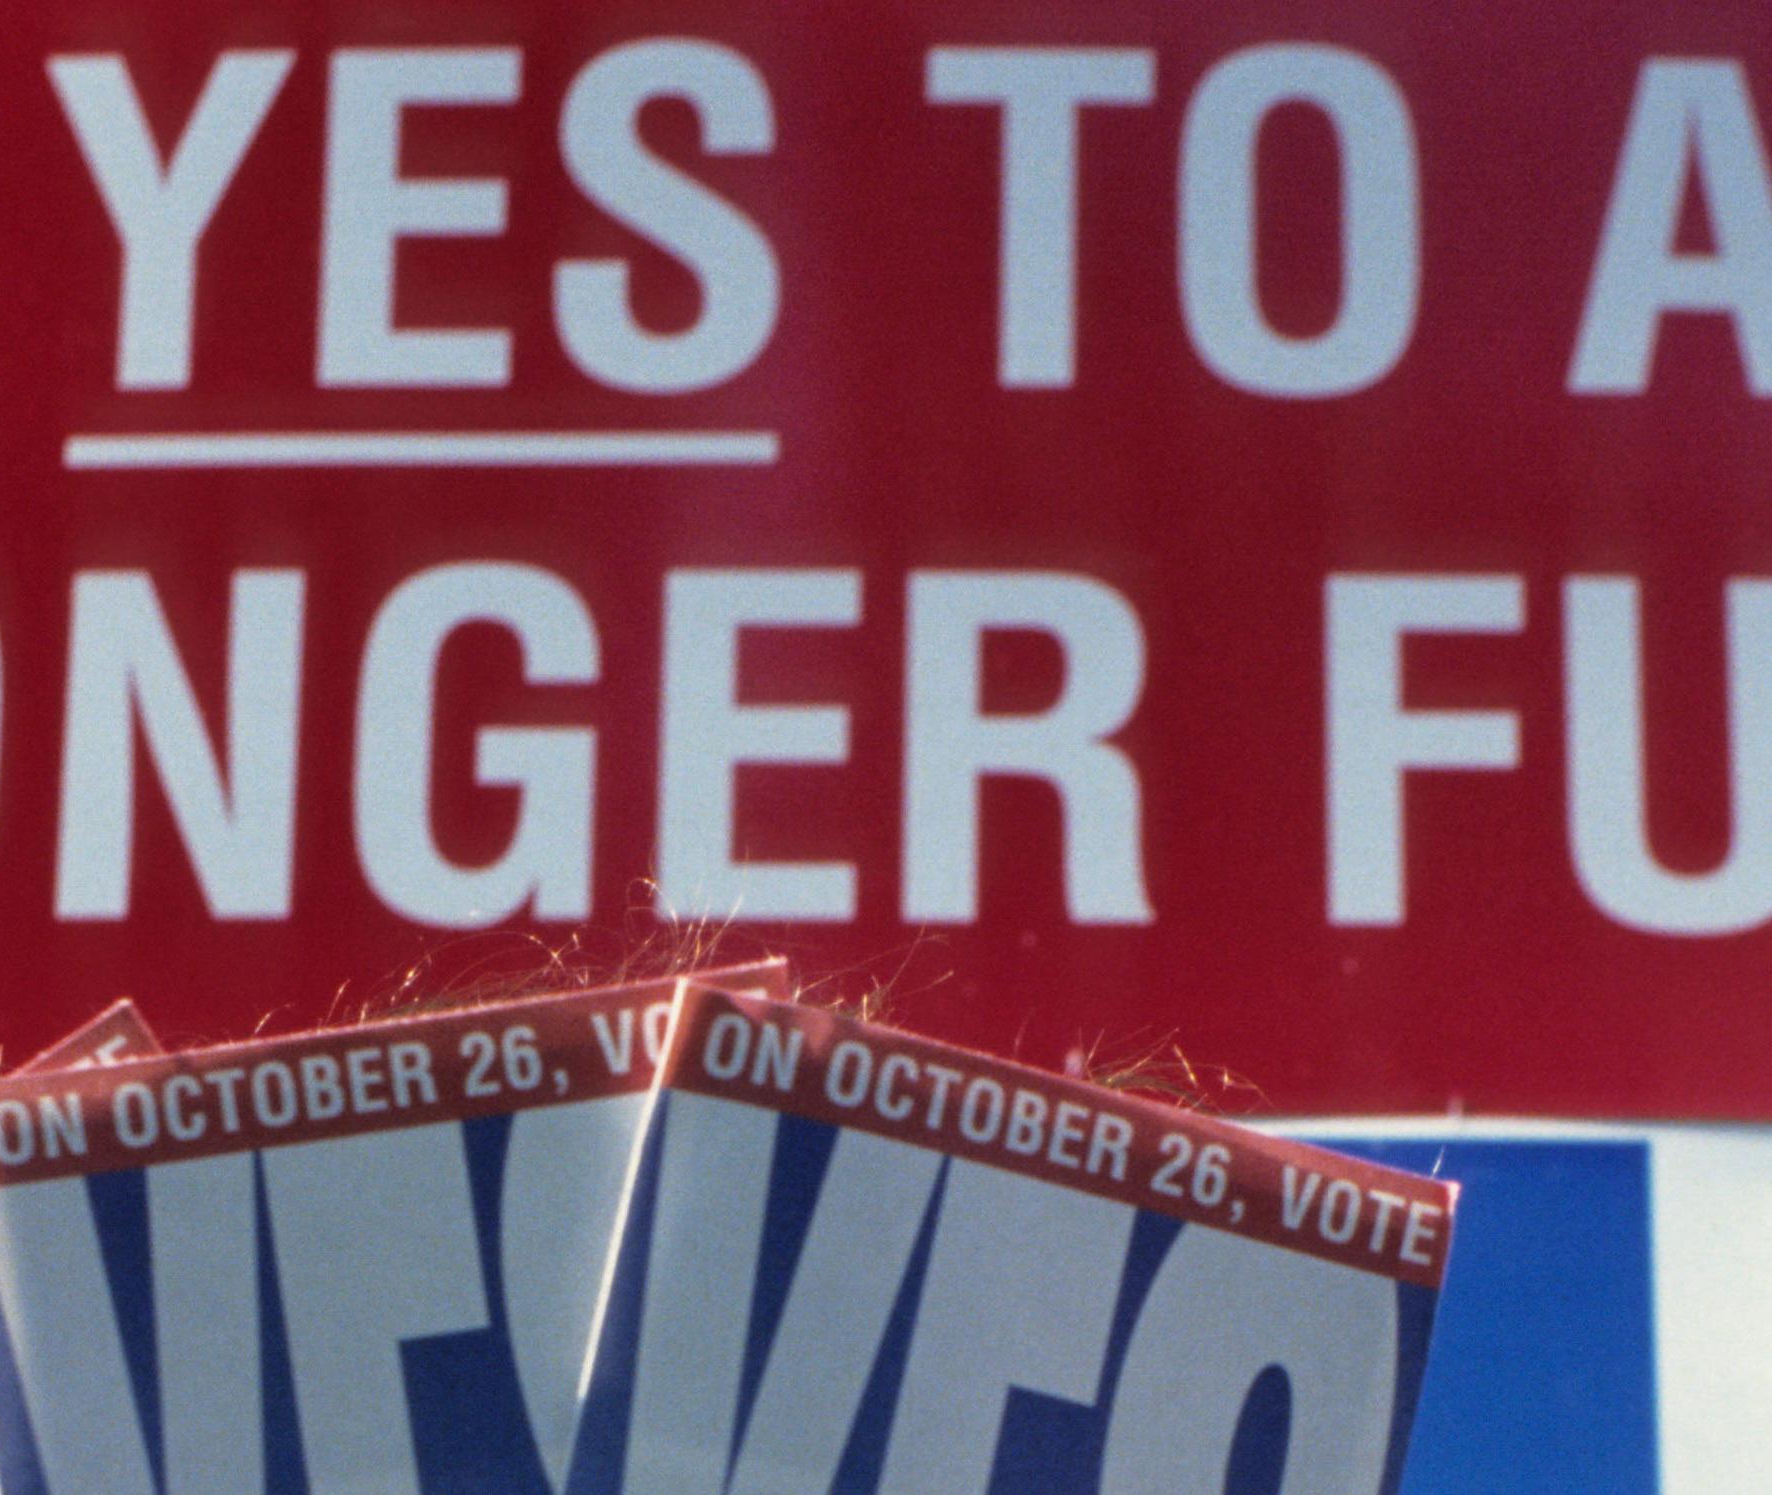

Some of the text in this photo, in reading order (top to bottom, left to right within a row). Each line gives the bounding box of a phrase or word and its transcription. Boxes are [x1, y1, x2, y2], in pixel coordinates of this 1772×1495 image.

[46, 37, 784, 394] YES
[925, 42, 1424, 400] TO
[110, 1040, 438, 1150] OCTOBER
[459, 1025, 570, 1097] 26,
[589, 1001, 674, 1077] VO
[703, 1012, 1444, 1266] ON OCTOBER 26, VOTE
